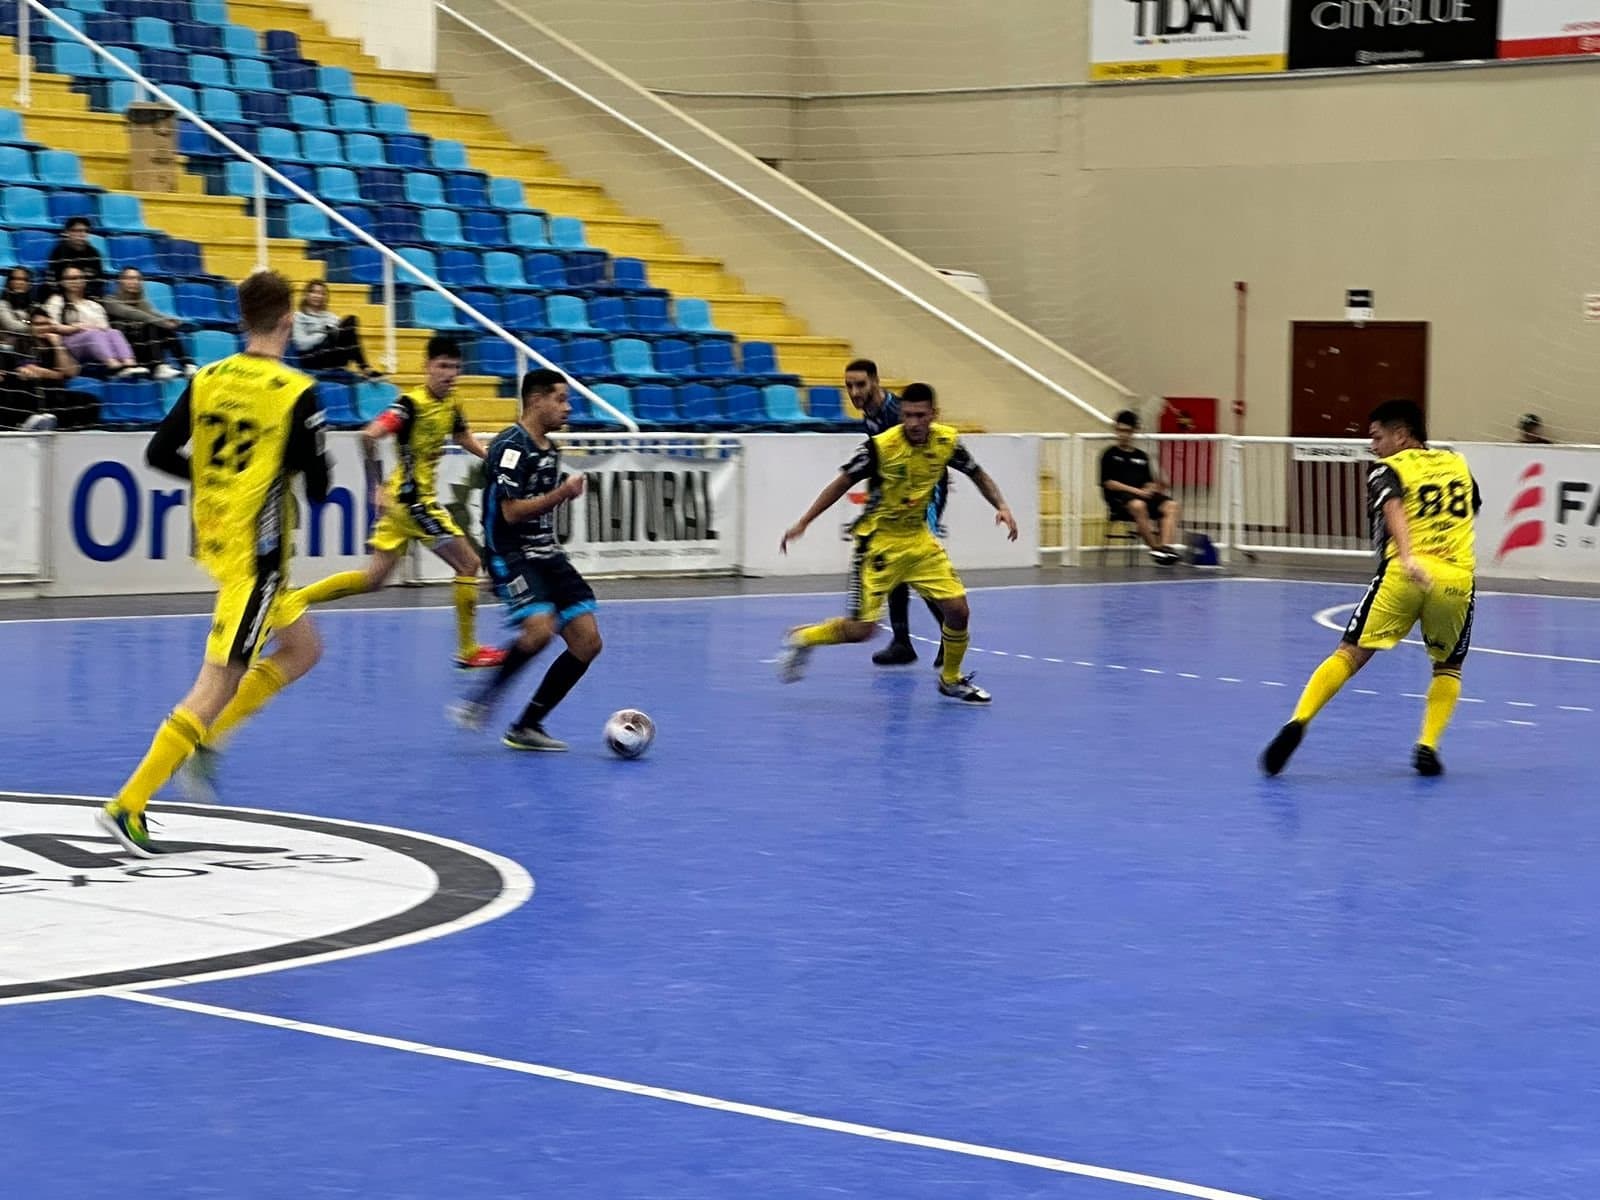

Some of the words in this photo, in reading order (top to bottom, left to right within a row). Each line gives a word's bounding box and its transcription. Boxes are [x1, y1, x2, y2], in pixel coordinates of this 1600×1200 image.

[1126, 0, 1250, 36] TIDAN
[584, 471, 720, 543] NATURAL
[1415, 479, 1469, 519] 88
